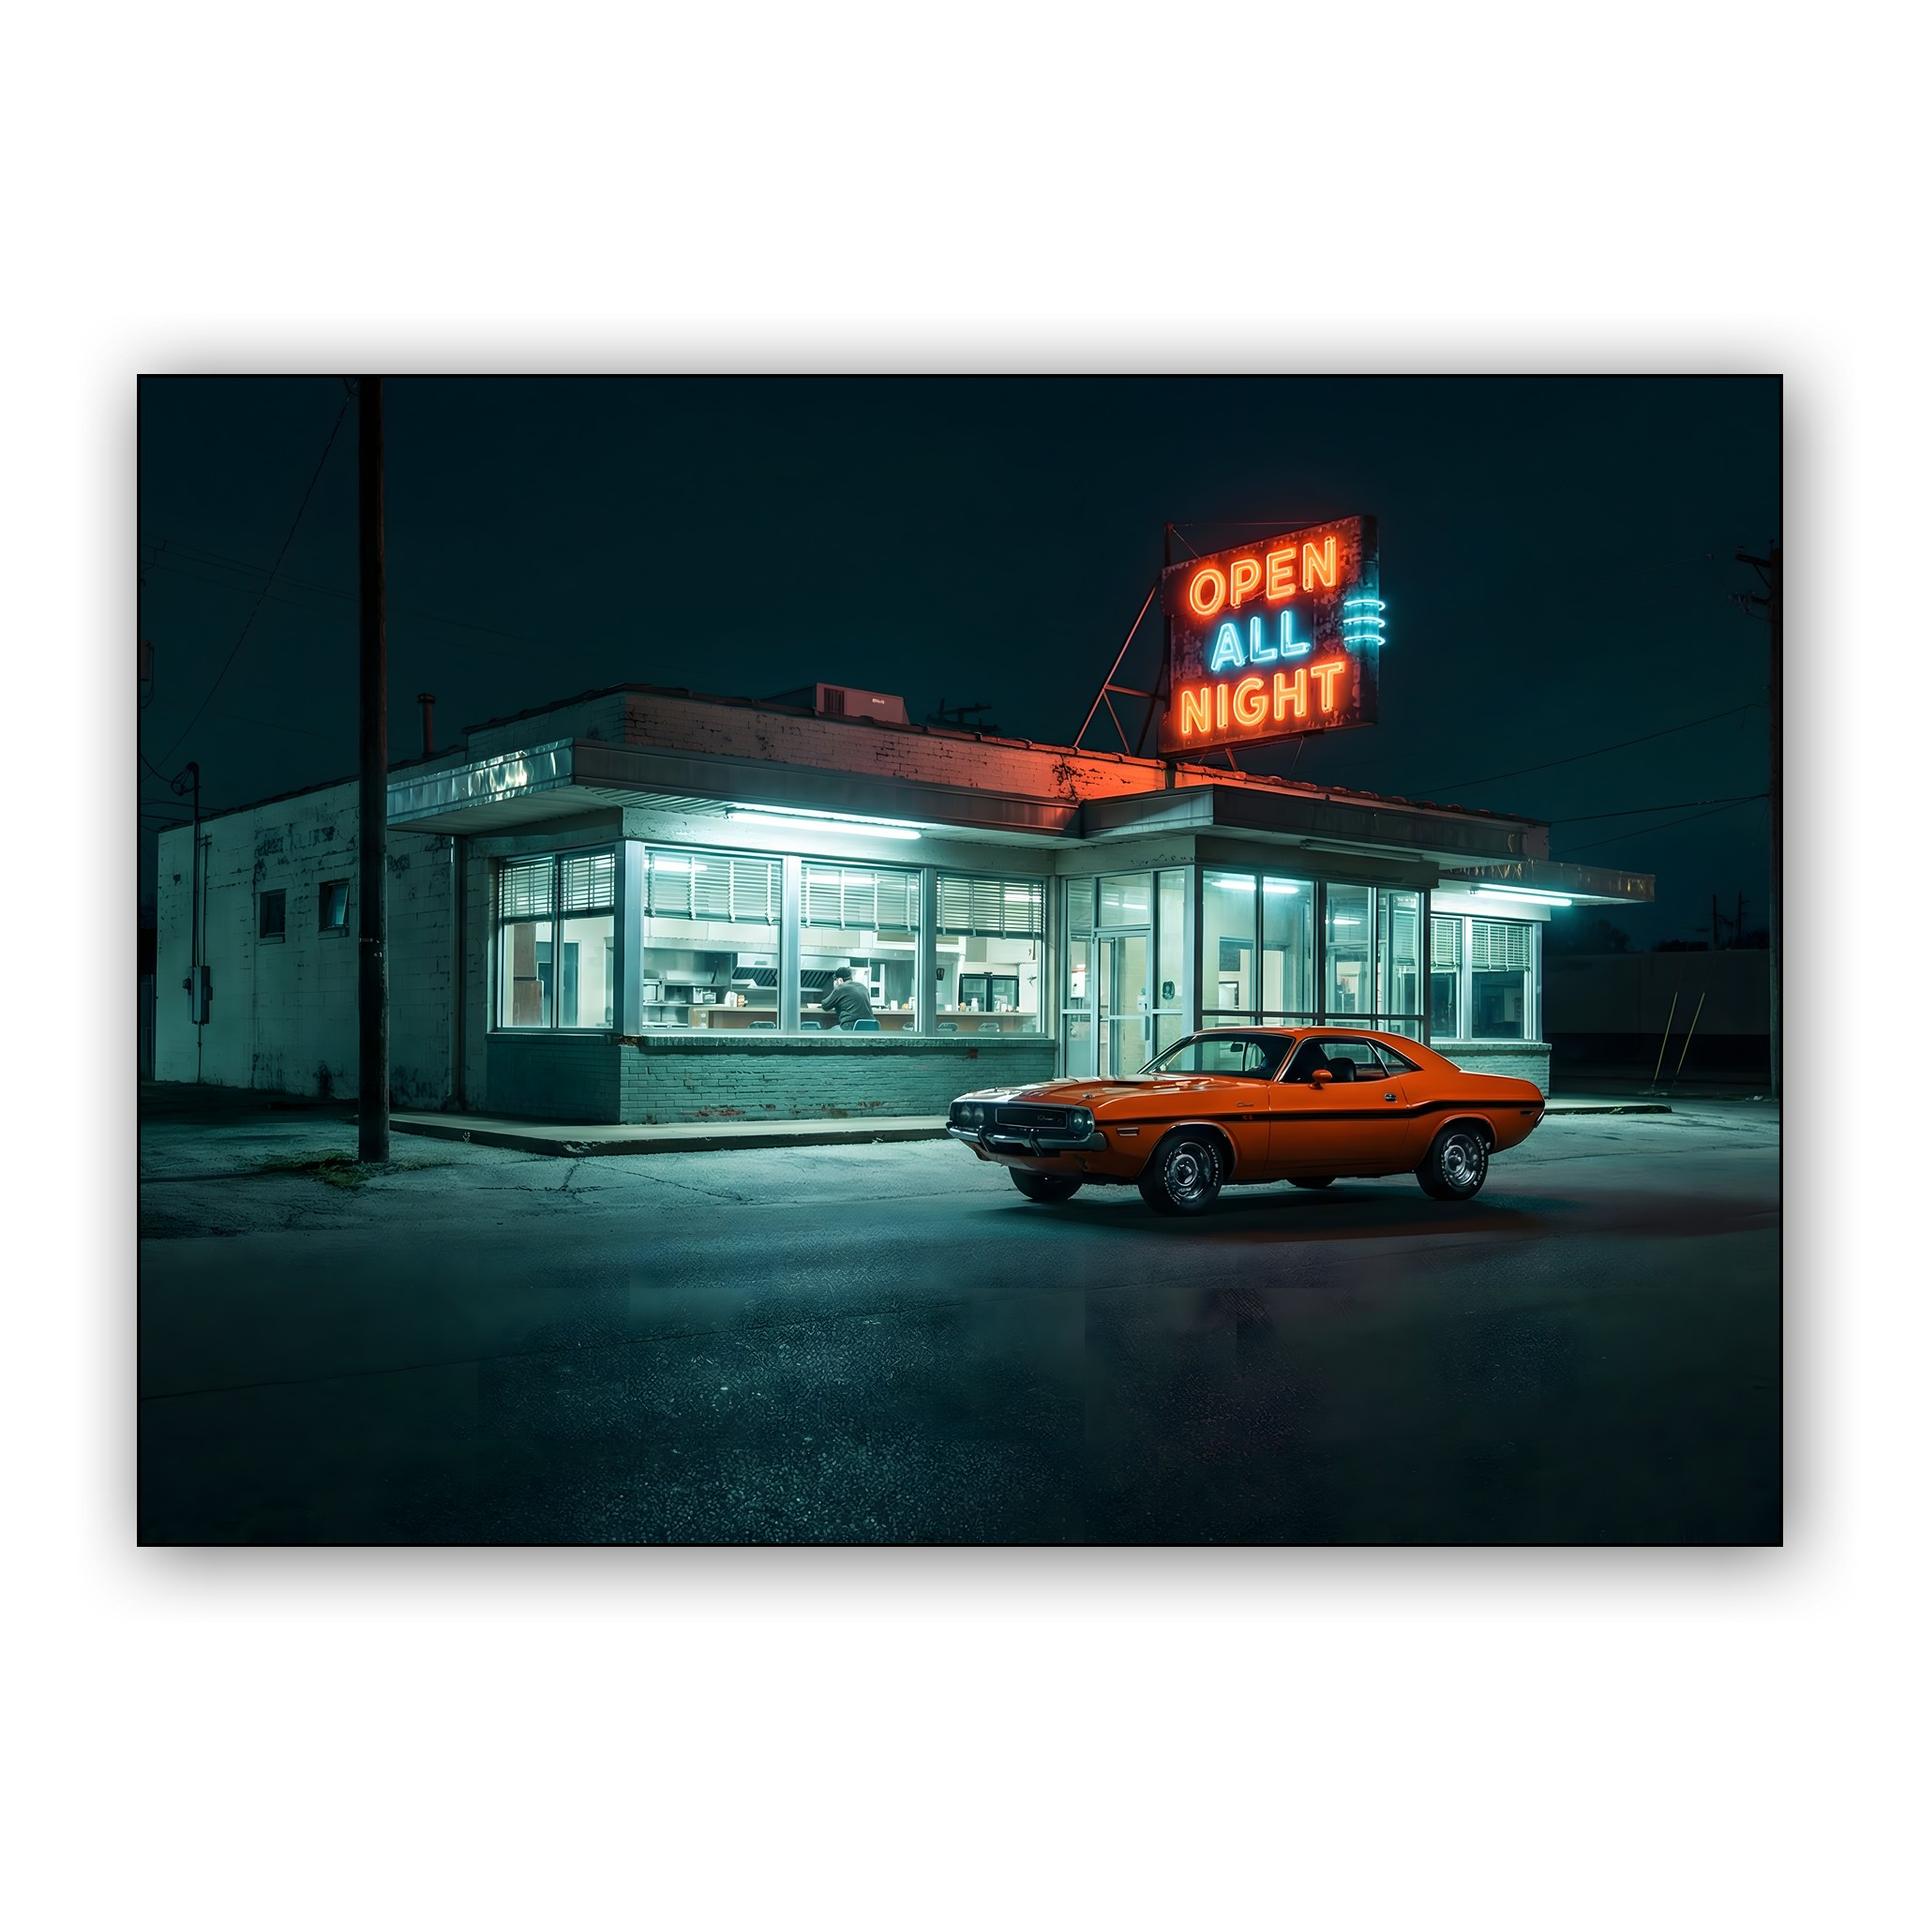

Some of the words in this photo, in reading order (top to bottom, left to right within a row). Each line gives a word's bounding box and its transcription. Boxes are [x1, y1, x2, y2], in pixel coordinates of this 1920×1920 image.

[1189, 536, 1337, 615] OPEN
[1210, 609, 1311, 671] ALL
[1181, 662, 1345, 734] NIGHT
